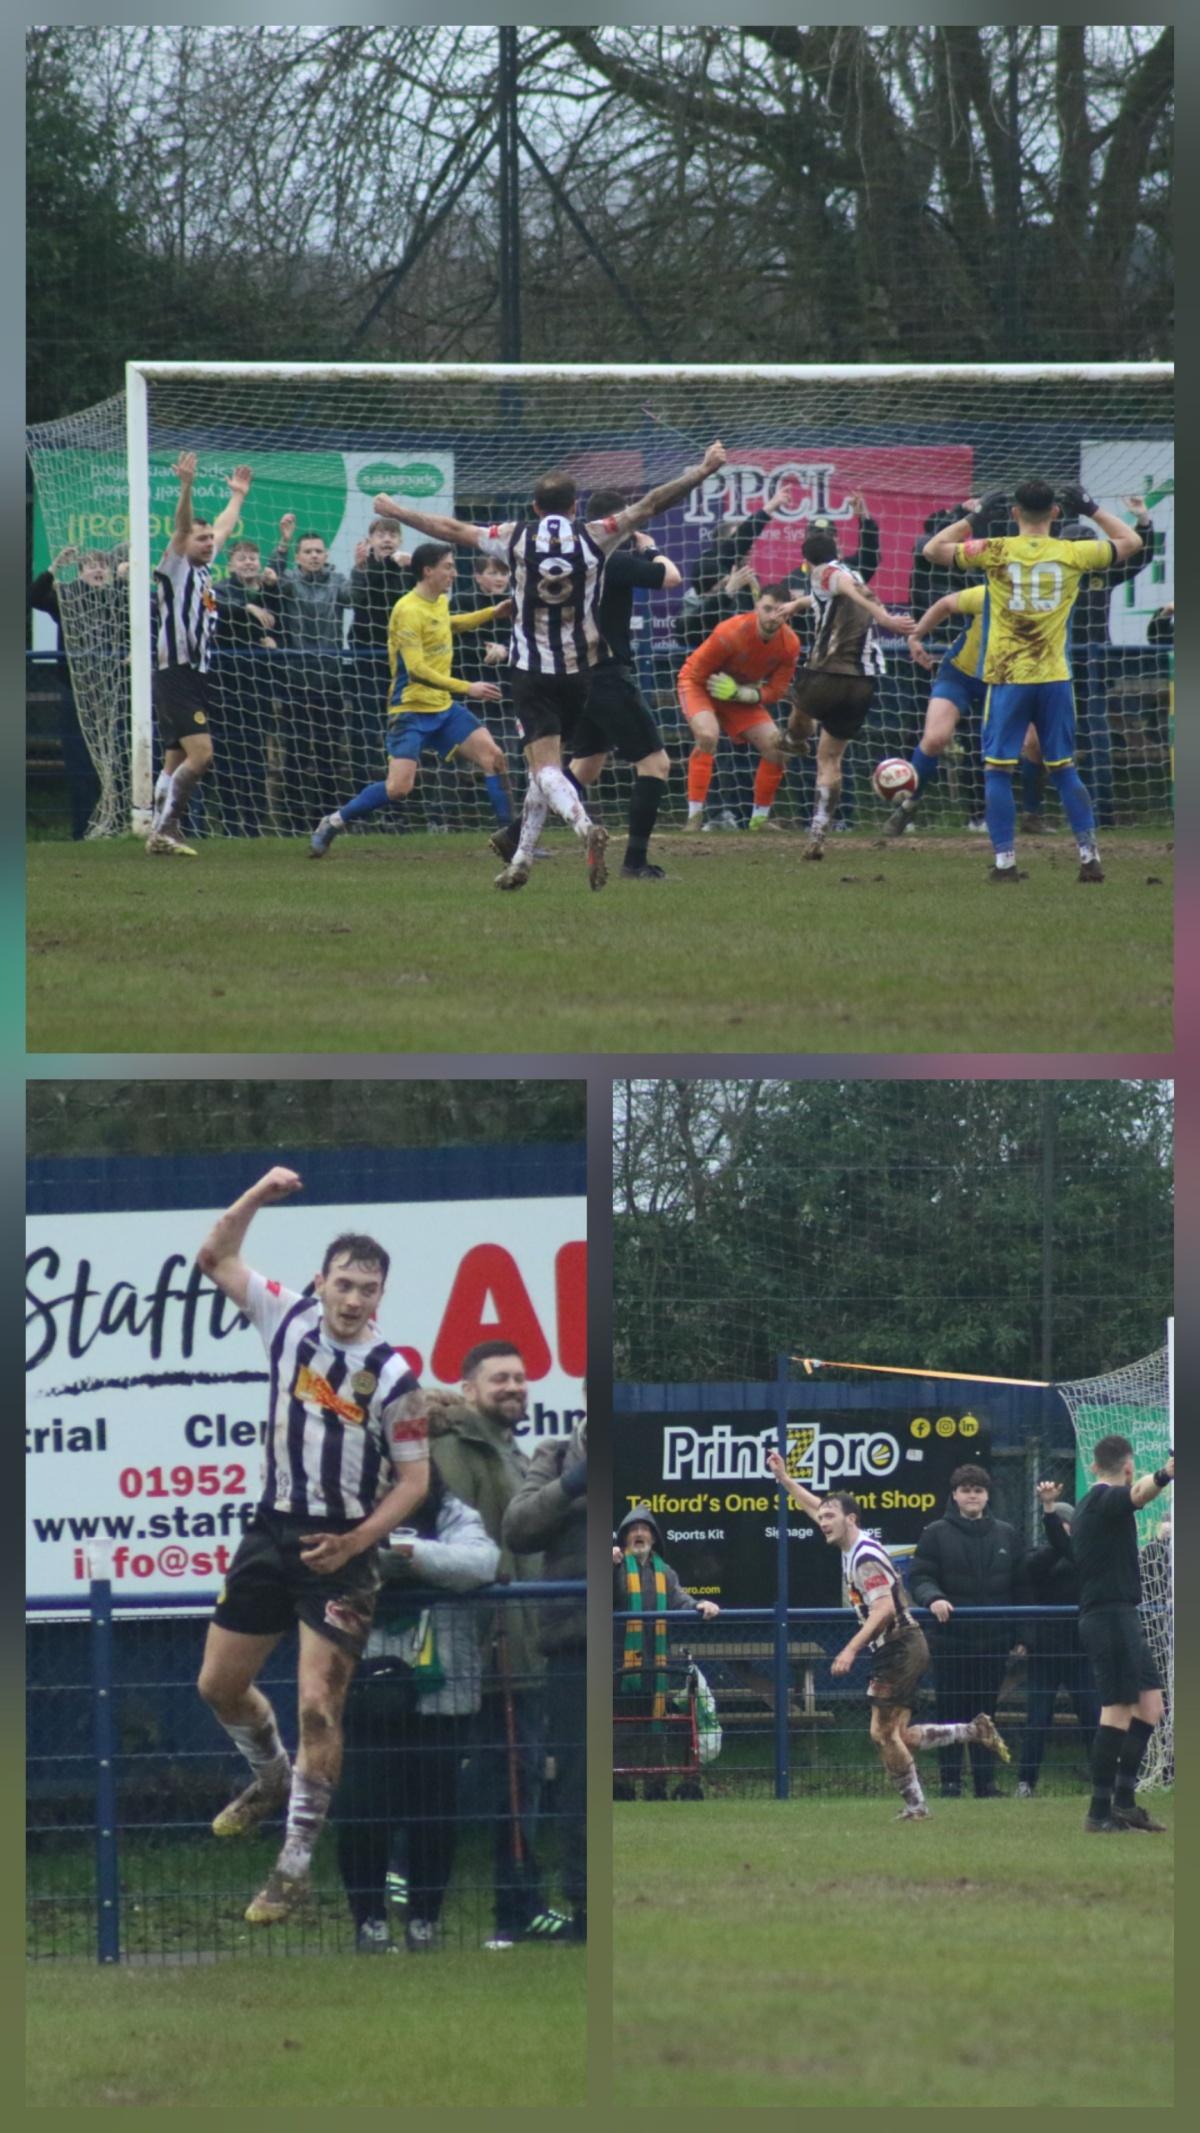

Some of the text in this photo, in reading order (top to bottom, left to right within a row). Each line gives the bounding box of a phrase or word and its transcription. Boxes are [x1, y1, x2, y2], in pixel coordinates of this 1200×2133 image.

[684, 463, 853, 522] PPCL
[537, 557, 574, 604] 8
[1008, 561, 1062, 611] 10
[119, 1464, 246, 1498] 01952
[725, 1494, 768, 1512] One
[880, 1490, 936, 1512] Shop
[33, 1502, 257, 1542] www.staff
[667, 1529, 706, 1542] Sports
[708, 1529, 725, 1540] Kit
[74, 1545, 230, 1580] ifo@st
